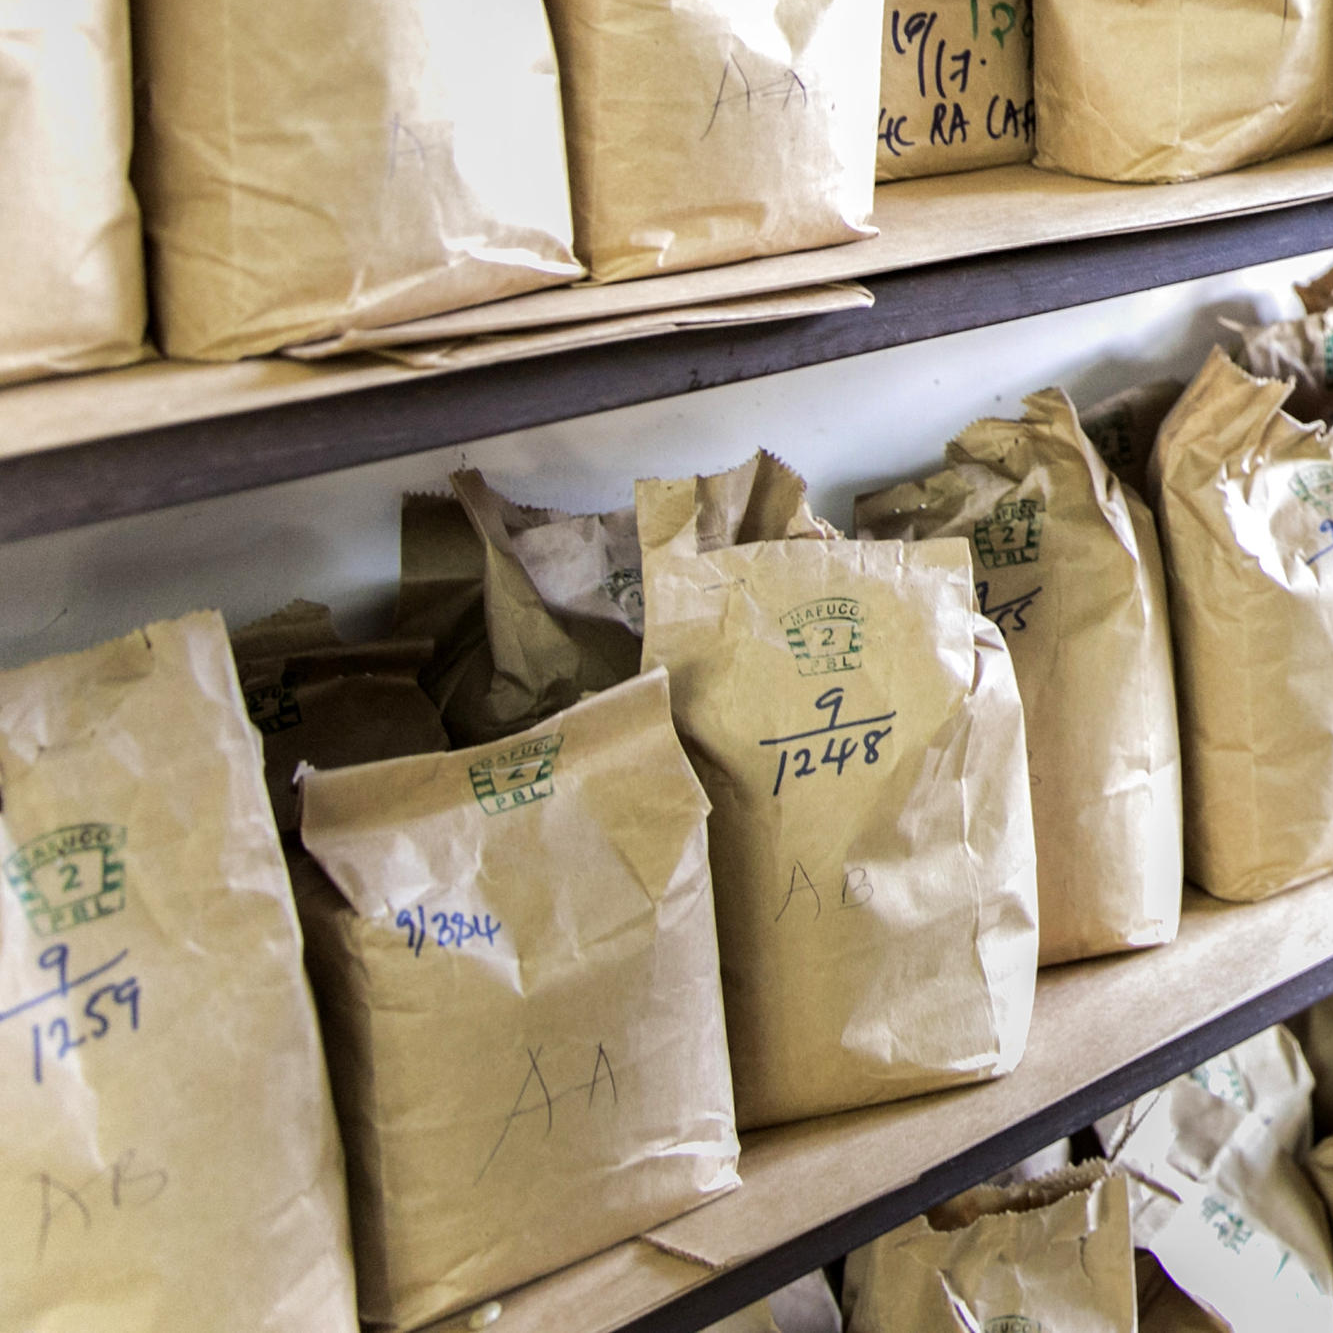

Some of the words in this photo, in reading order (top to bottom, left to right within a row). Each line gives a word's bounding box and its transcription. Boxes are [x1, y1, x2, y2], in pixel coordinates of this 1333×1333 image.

[930, 102, 971, 146] RA
[1001, 525, 1016, 544] 2
[791, 602, 860, 627] MAFUCO
[820, 627, 836, 647] 2
[814, 687, 845, 730] 9
[772, 725, 893, 797] 1248
[495, 784, 548, 809] PBL
[58, 863, 83, 893] 2
[37, 942, 69, 998] 9
[32, 975, 140, 1084] 1259
